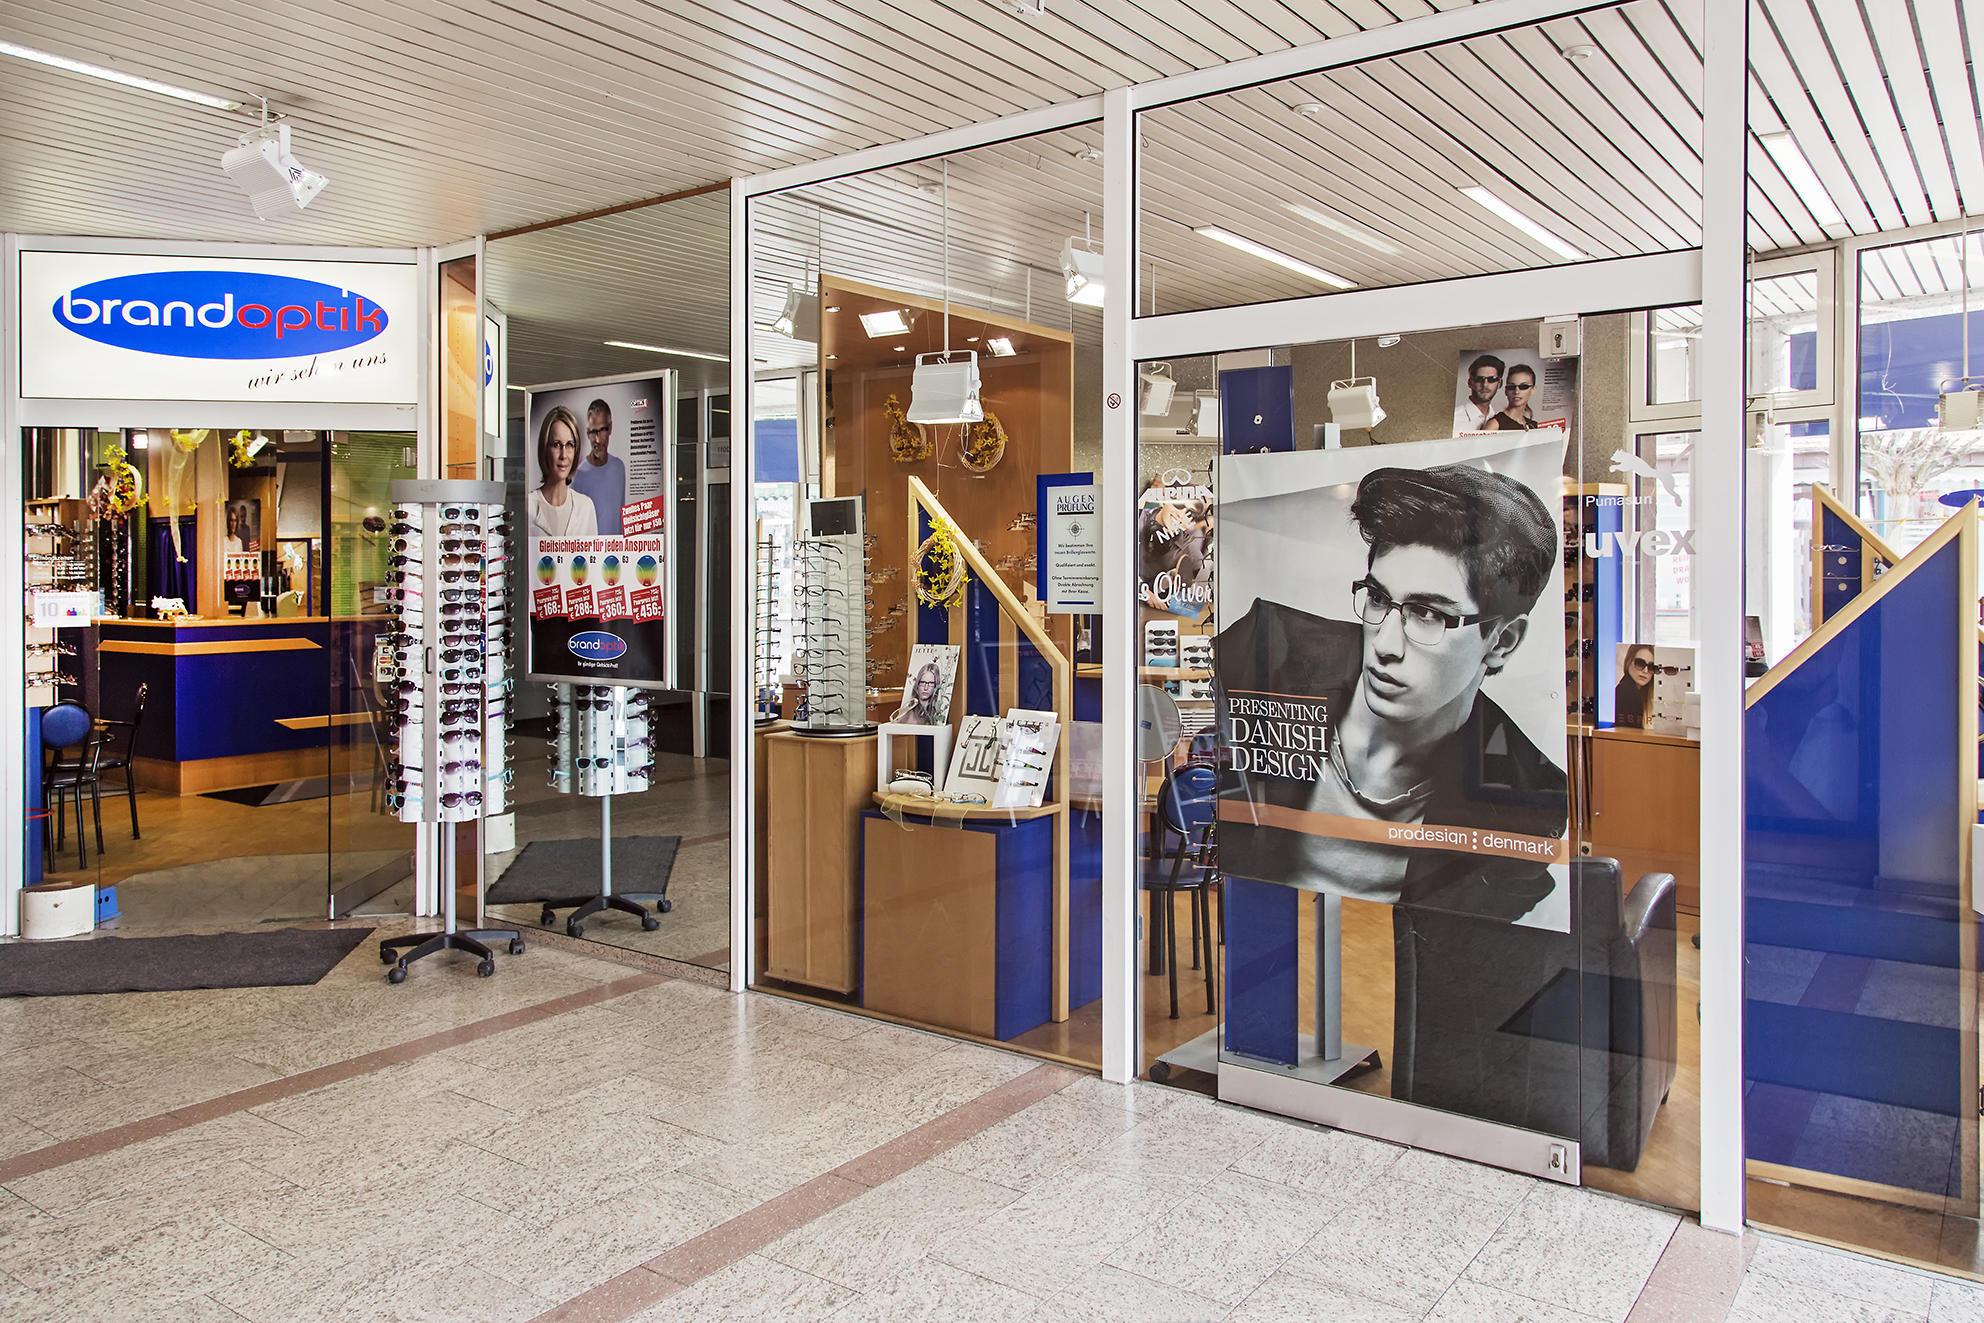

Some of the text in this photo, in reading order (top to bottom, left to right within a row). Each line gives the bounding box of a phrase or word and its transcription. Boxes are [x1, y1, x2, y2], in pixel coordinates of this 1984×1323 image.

[62, 288, 384, 340] brandoptik
[248, 368, 284, 389] wir
[352, 352, 386, 369] uns
[1056, 502, 1095, 512] PRÜFUNG
[1057, 494, 1095, 503] AUGEN
[1585, 495, 1653, 508] Pumasun
[539, 538, 661, 553] Gleitsichtgläser für jeden Anspruch
[1585, 530, 1697, 559] uvex
[568, 637, 626, 654] brandoptik
[1228, 697, 1329, 724] PRESENTING
[1229, 717, 1329, 753] DANISH
[1229, 746, 1329, 784] DESIGN
[1388, 826, 1555, 857] prodesign denmark
